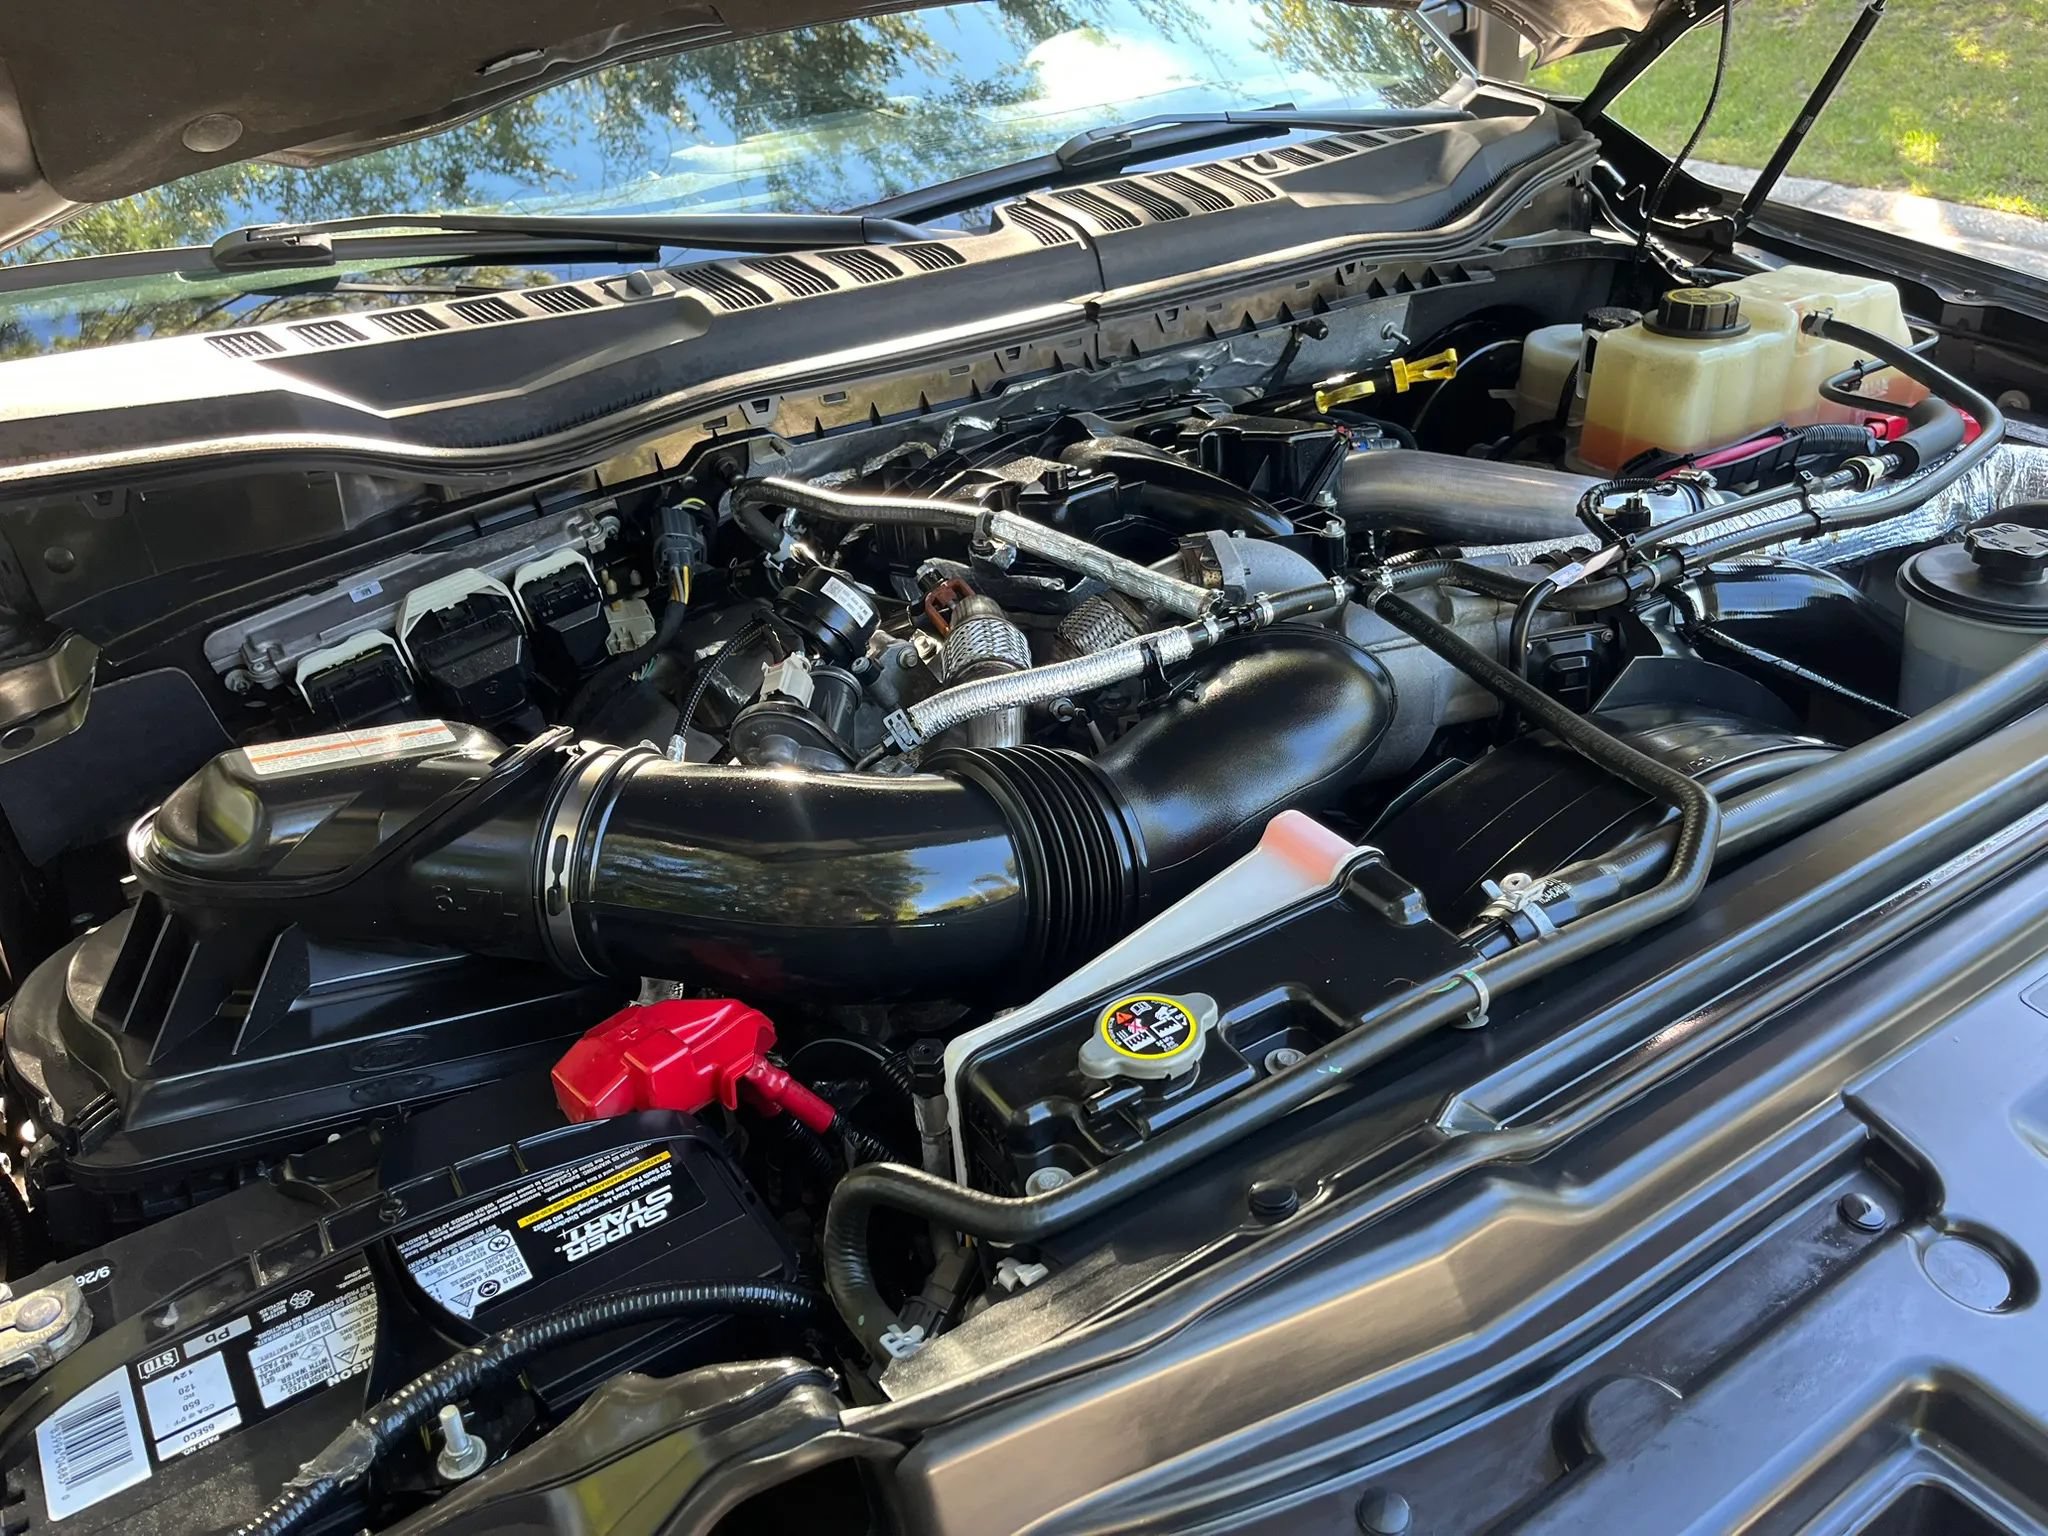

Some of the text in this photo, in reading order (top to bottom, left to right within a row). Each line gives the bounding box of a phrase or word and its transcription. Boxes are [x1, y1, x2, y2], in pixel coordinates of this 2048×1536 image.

[625, 1156, 662, 1175] NATIONWIDE
[589, 1174, 623, 1192] WARRANTY
[563, 1186, 671, 1249] START
[567, 1204, 666, 1260] SUPER
[75, 1266, 109, 1286] 9/26
[459, 1257, 520, 1289] EXPLOSIVE GASES
[502, 1268, 526, 1283] SHIELD
[306, 1324, 319, 1333] NOT
[308, 1329, 320, 1338] NOT
[321, 1323, 331, 1332] DO
[204, 1325, 229, 1346] Pb
[289, 1336, 306, 1347] OPEN
[144, 1352, 172, 1372] STD
[280, 1351, 298, 1363] HELP
[309, 1357, 327, 1369] WITH
[172, 1369, 192, 1382] 12V
[259, 1361, 292, 1379] MEDICAL
[280, 1363, 330, 1390] IMMEDIATELY
[178, 1383, 194, 1395] 120
[261, 1376, 275, 1387] GET
[287, 1369, 332, 1394] FLUSH EYES
[182, 1399, 200, 1411] 650
[197, 1403, 214, 1413] CCA
[183, 1423, 214, 1442] 65ECO
[198, 1435, 219, 1448] PART
